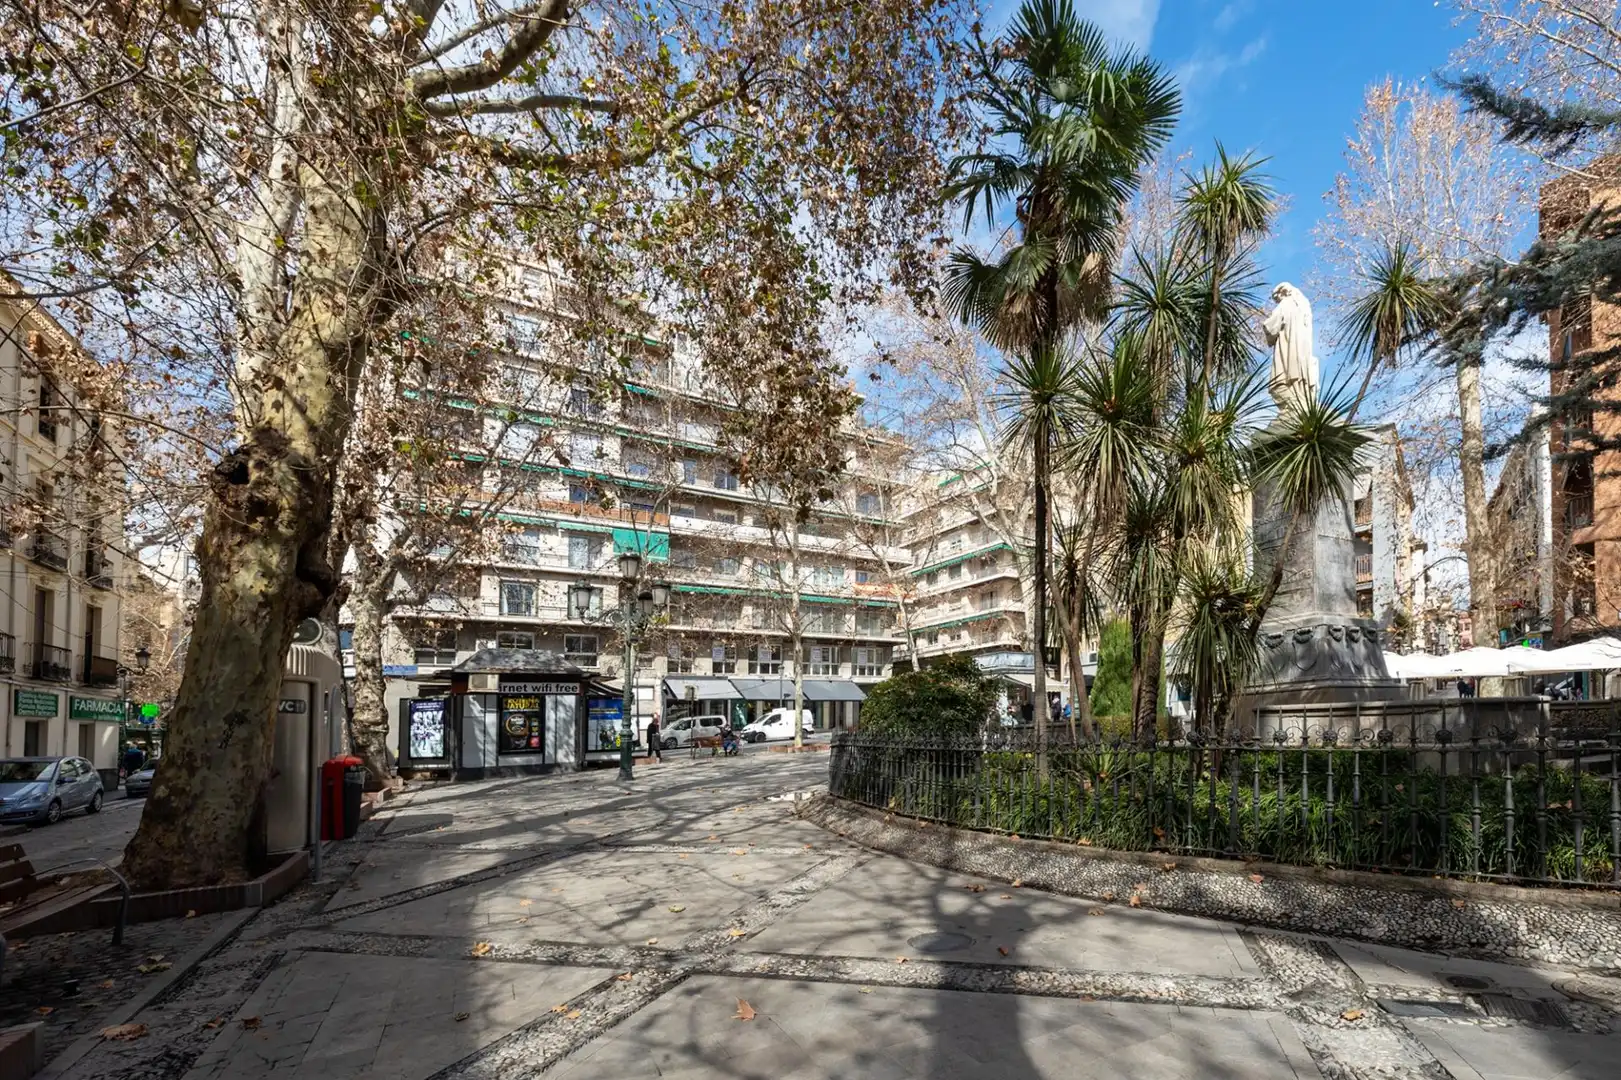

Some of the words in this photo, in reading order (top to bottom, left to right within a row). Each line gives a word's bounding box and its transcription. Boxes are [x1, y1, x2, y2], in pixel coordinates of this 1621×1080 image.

[531, 683, 552, 692] wifi
[555, 683, 578, 692] free
[74, 698, 122, 714] FARMACIA
